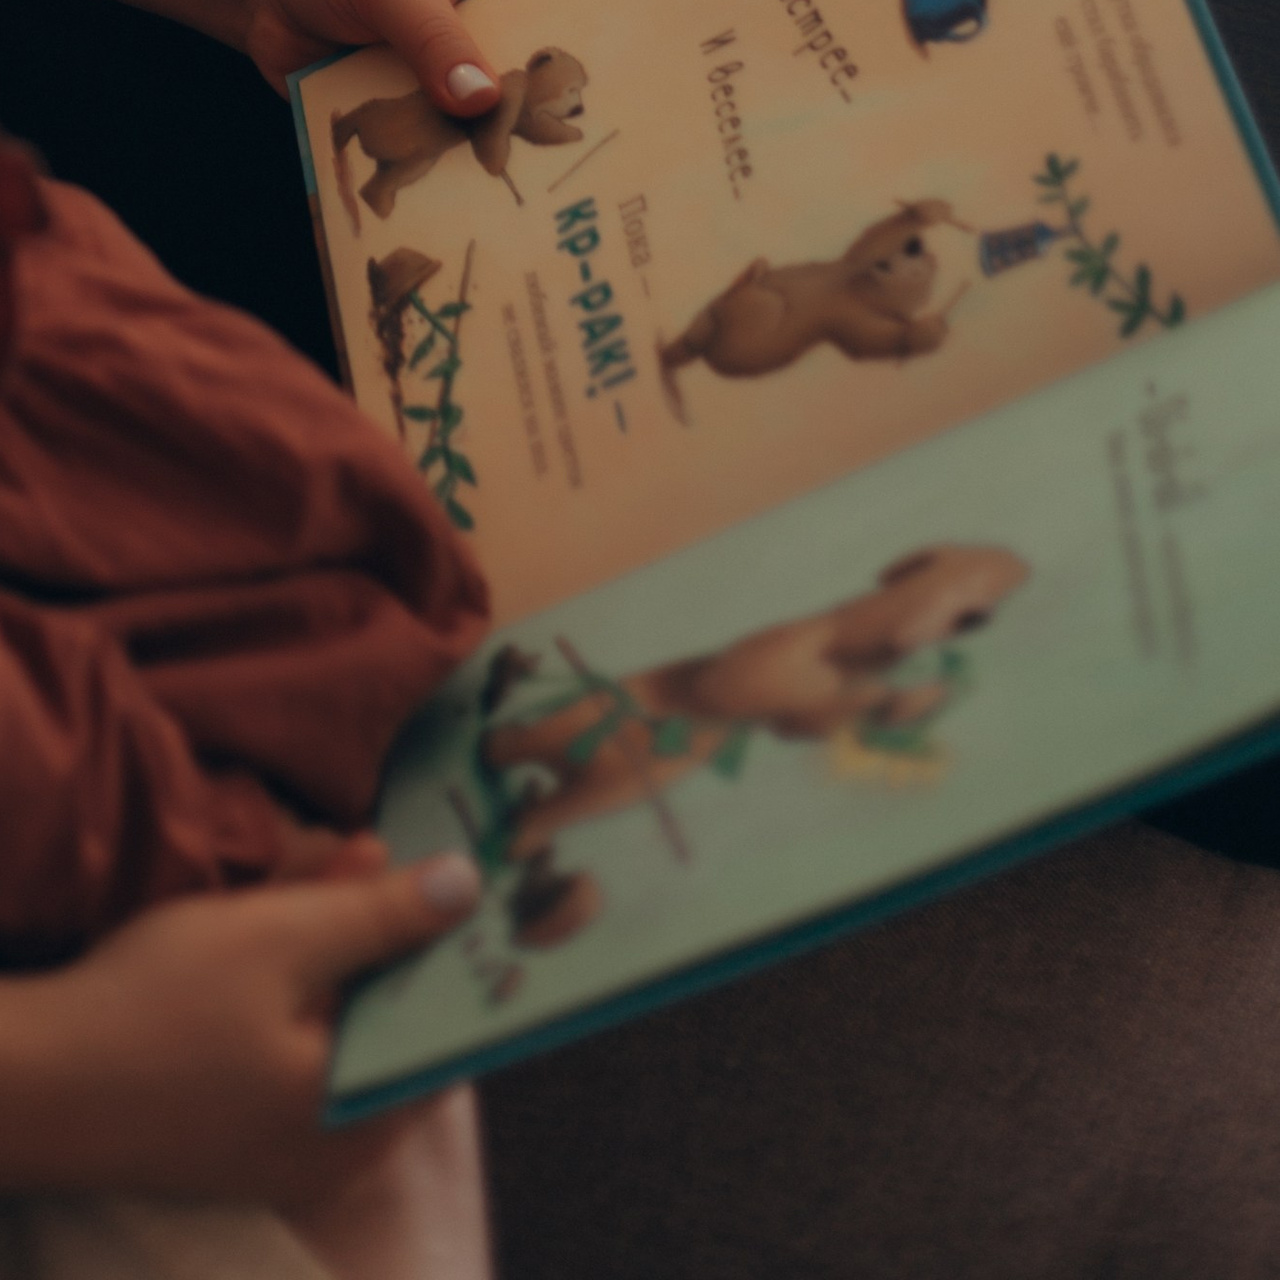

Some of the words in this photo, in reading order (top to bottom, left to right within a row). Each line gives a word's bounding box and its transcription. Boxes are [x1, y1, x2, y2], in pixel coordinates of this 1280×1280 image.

[700, 28, 737, 55] И
[617, 193, 653, 270] Пока
[554, 197, 638, 400] КР-РАК!
